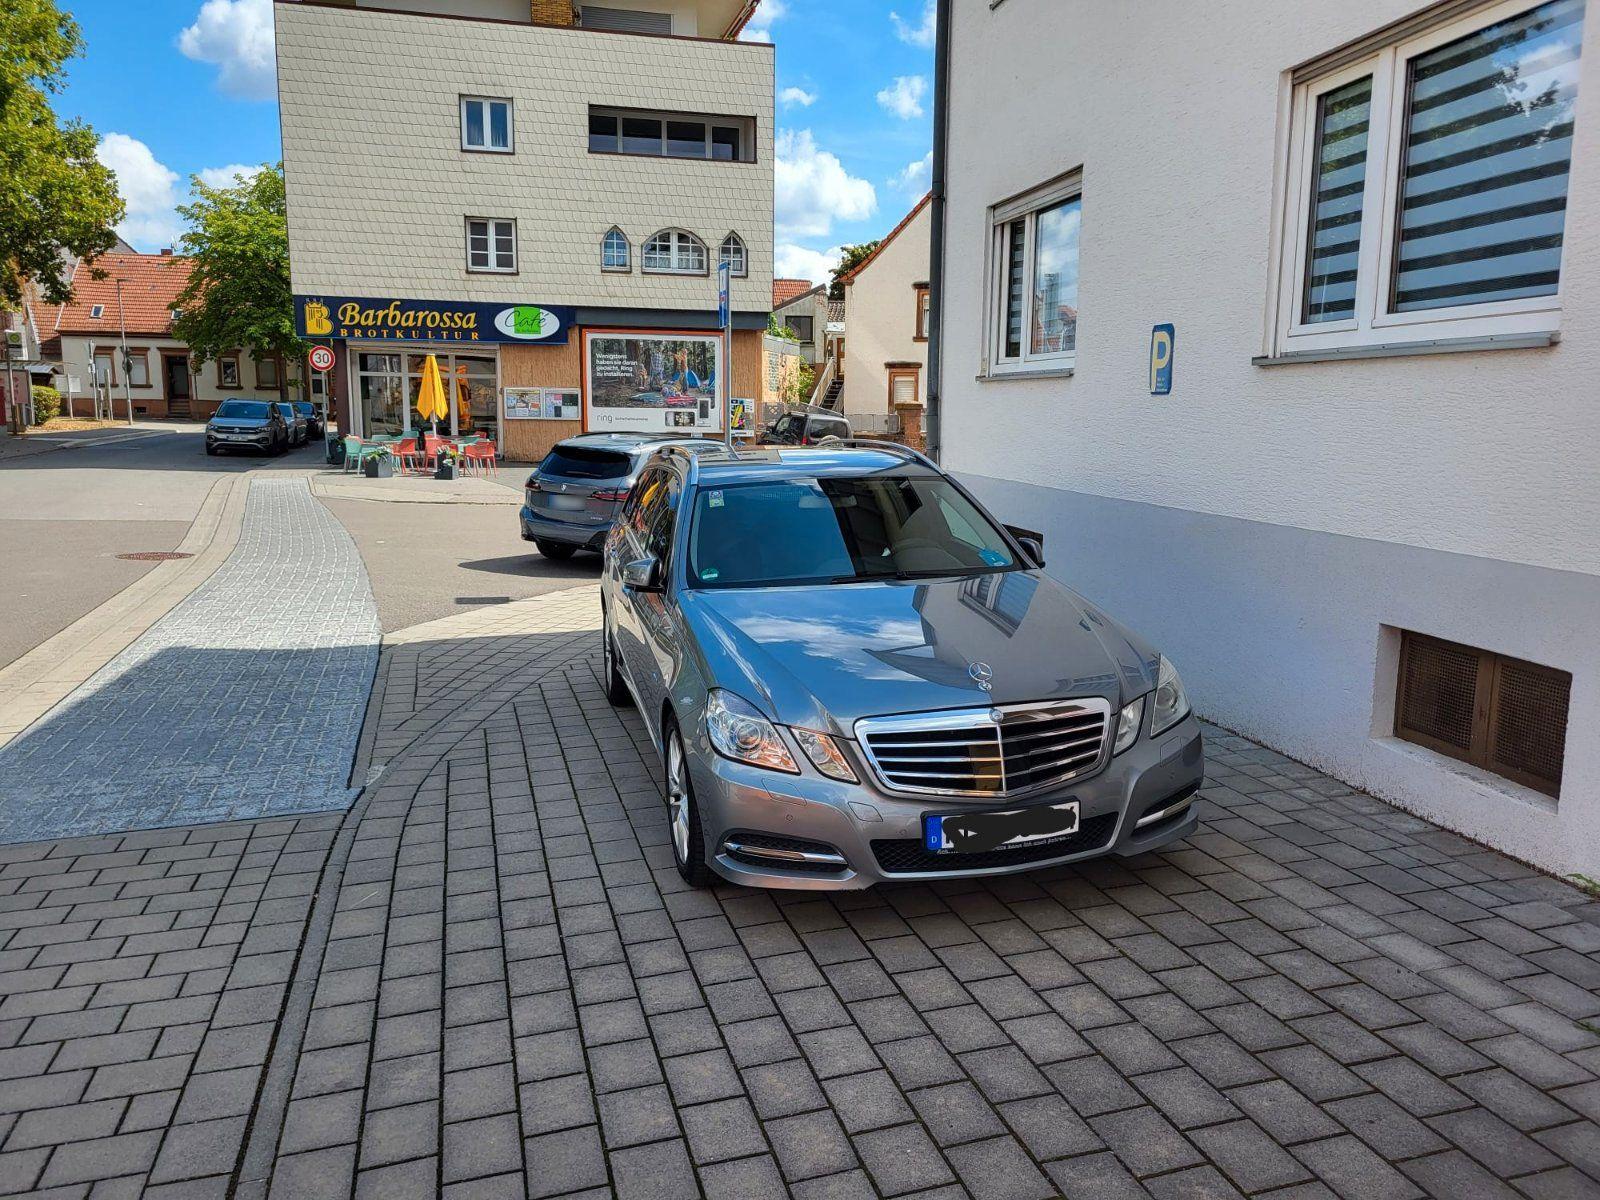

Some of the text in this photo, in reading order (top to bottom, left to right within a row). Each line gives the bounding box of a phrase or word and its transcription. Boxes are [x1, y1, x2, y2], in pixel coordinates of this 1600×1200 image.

[338, 301, 477, 329] Barbarossa
[504, 310, 549, 329] Café
[340, 329, 479, 340] BROTKULTUR
[314, 352, 330, 364] 30
[1151, 331, 1171, 392] P
[596, 414, 612, 424] ring
